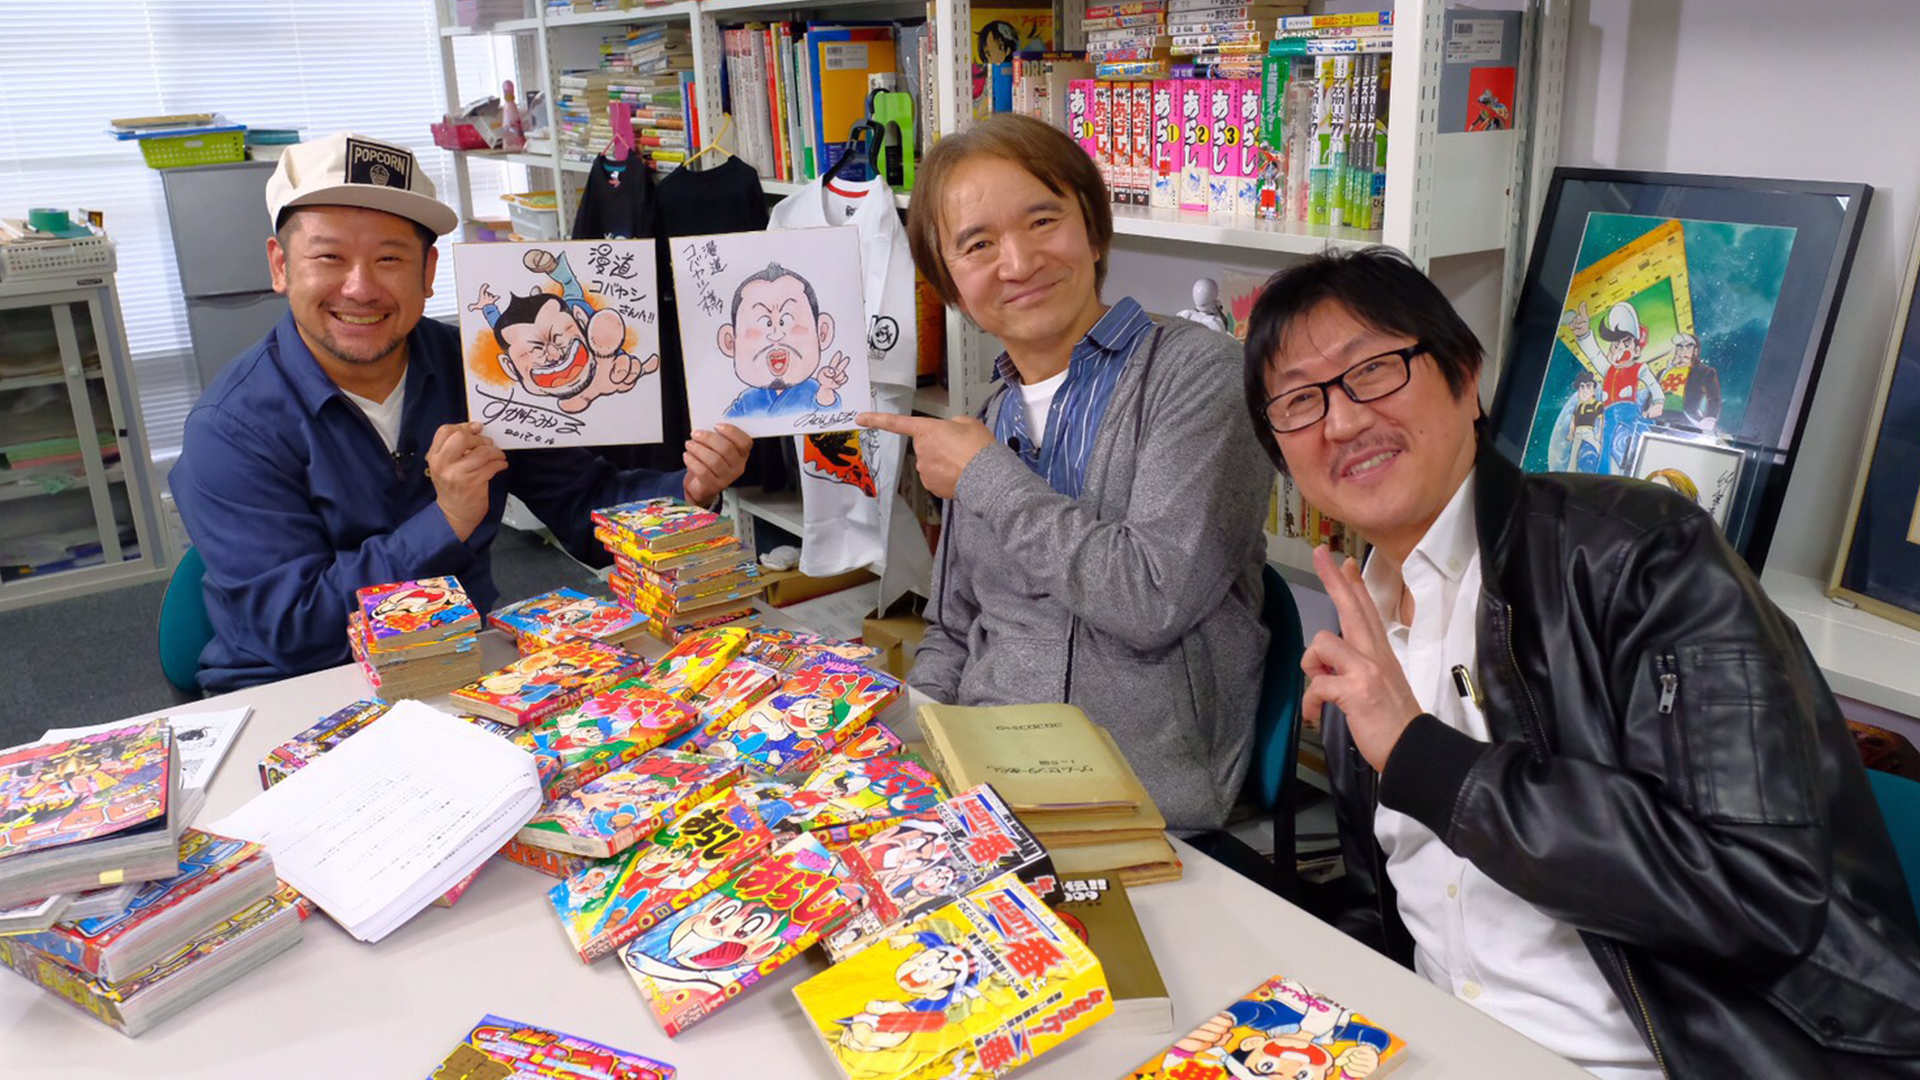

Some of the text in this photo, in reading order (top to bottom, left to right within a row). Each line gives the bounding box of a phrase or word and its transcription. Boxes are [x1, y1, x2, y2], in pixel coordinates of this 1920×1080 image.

[1069, 88, 1086, 140] あら
[1198, 126, 1205, 143] 2
[1211, 88, 1235, 174] あらし 3
[1241, 88, 1259, 175] あらし
[354, 147, 406, 175] POPCORN
[588, 243, 638, 278] 漫道
[701, 240, 727, 276] 漫道
[588, 280, 647, 302] コバヤシ
[680, 808, 742, 861] あらし
[731, 851, 847, 926] あらし
